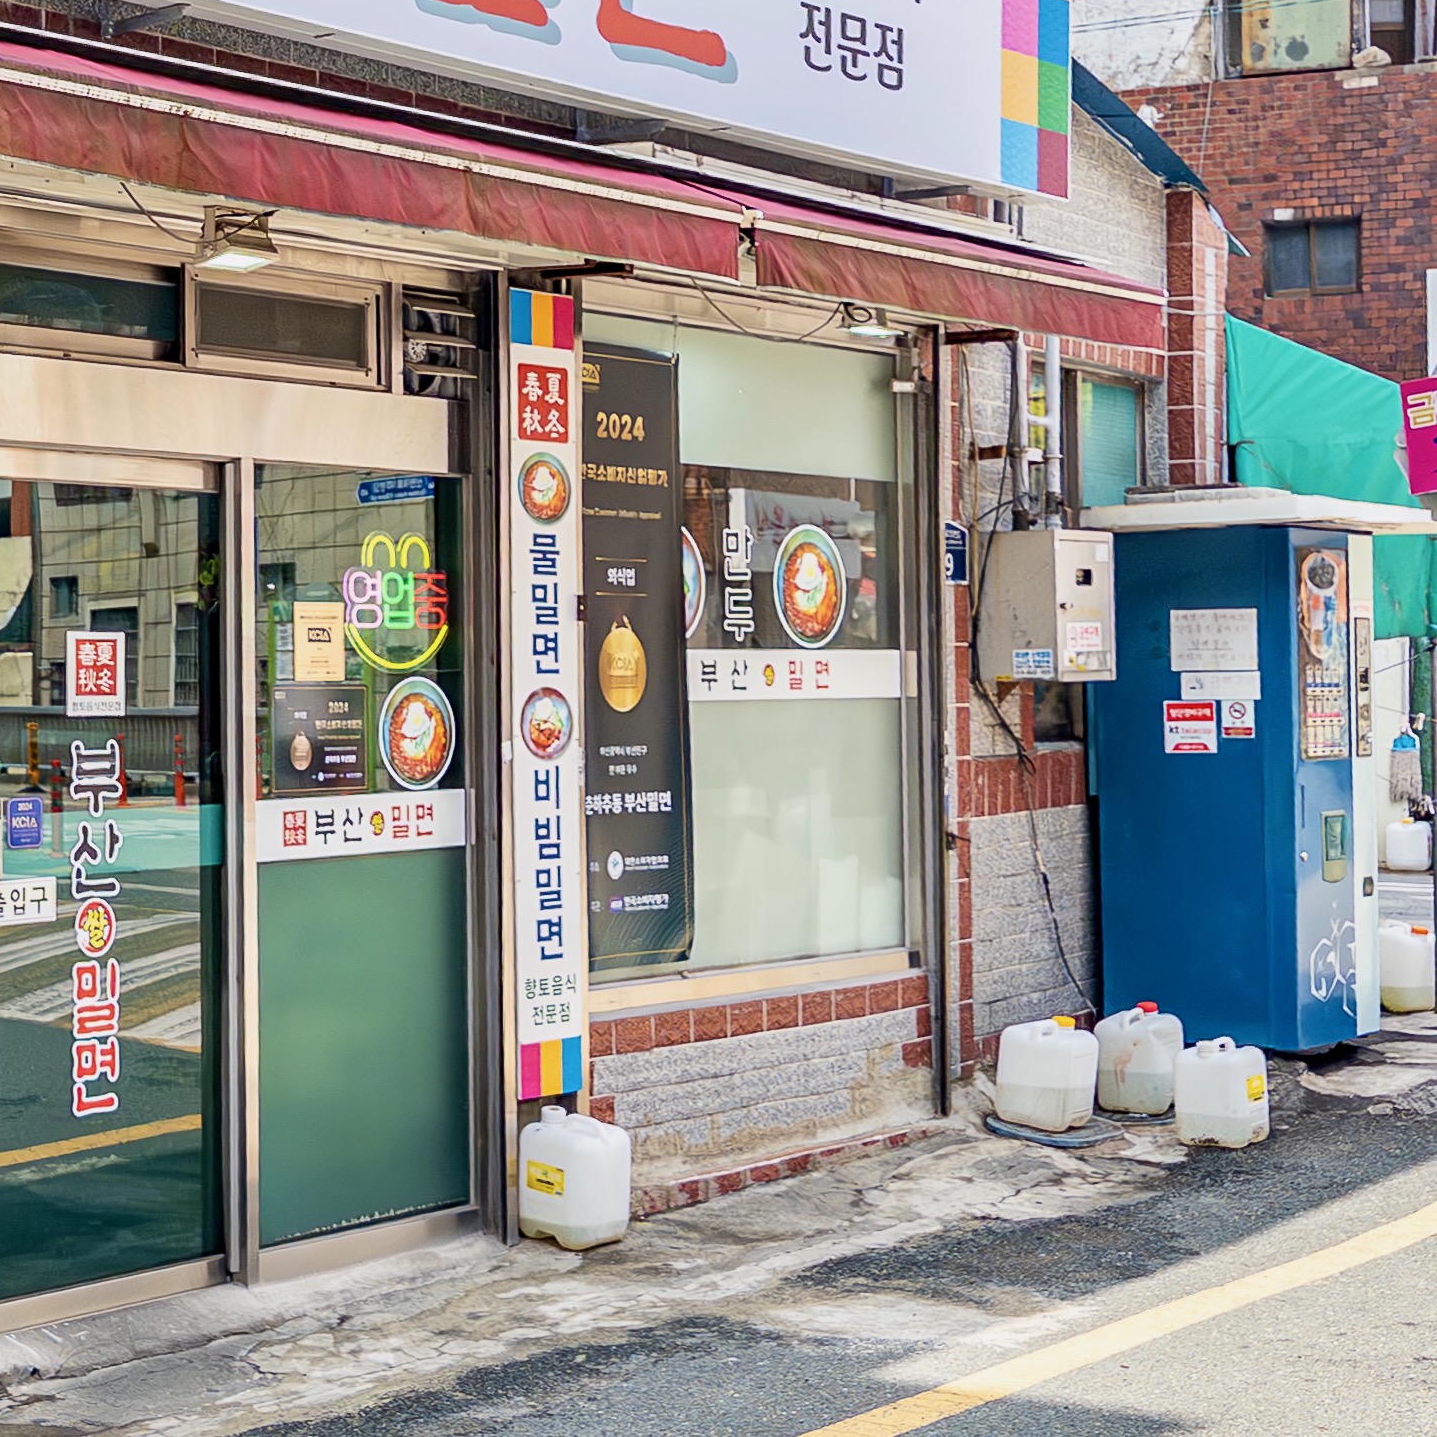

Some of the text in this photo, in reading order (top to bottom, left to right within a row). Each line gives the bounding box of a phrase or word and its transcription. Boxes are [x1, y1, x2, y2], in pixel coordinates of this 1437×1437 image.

[799, 0, 905, 91] 전문점
[596, 411, 646, 441] 2024
[1406, 389, 1437, 430] 금
[348, 569, 448, 630] 영업중
[529, 534, 561, 676] 물밀면
[701, 660, 748, 691] 부산
[788, 660, 830, 691] 밀면
[624, 791, 672, 813] 부산밀면
[12, 817, 38, 829] KCIA
[314, 807, 364, 844] 부산
[391, 803, 435, 839] 밀면
[534, 765, 564, 962] 비빔밀면
[525, 973, 577, 1000] 향토음식
[531, 1001, 572, 1027] 전문점
